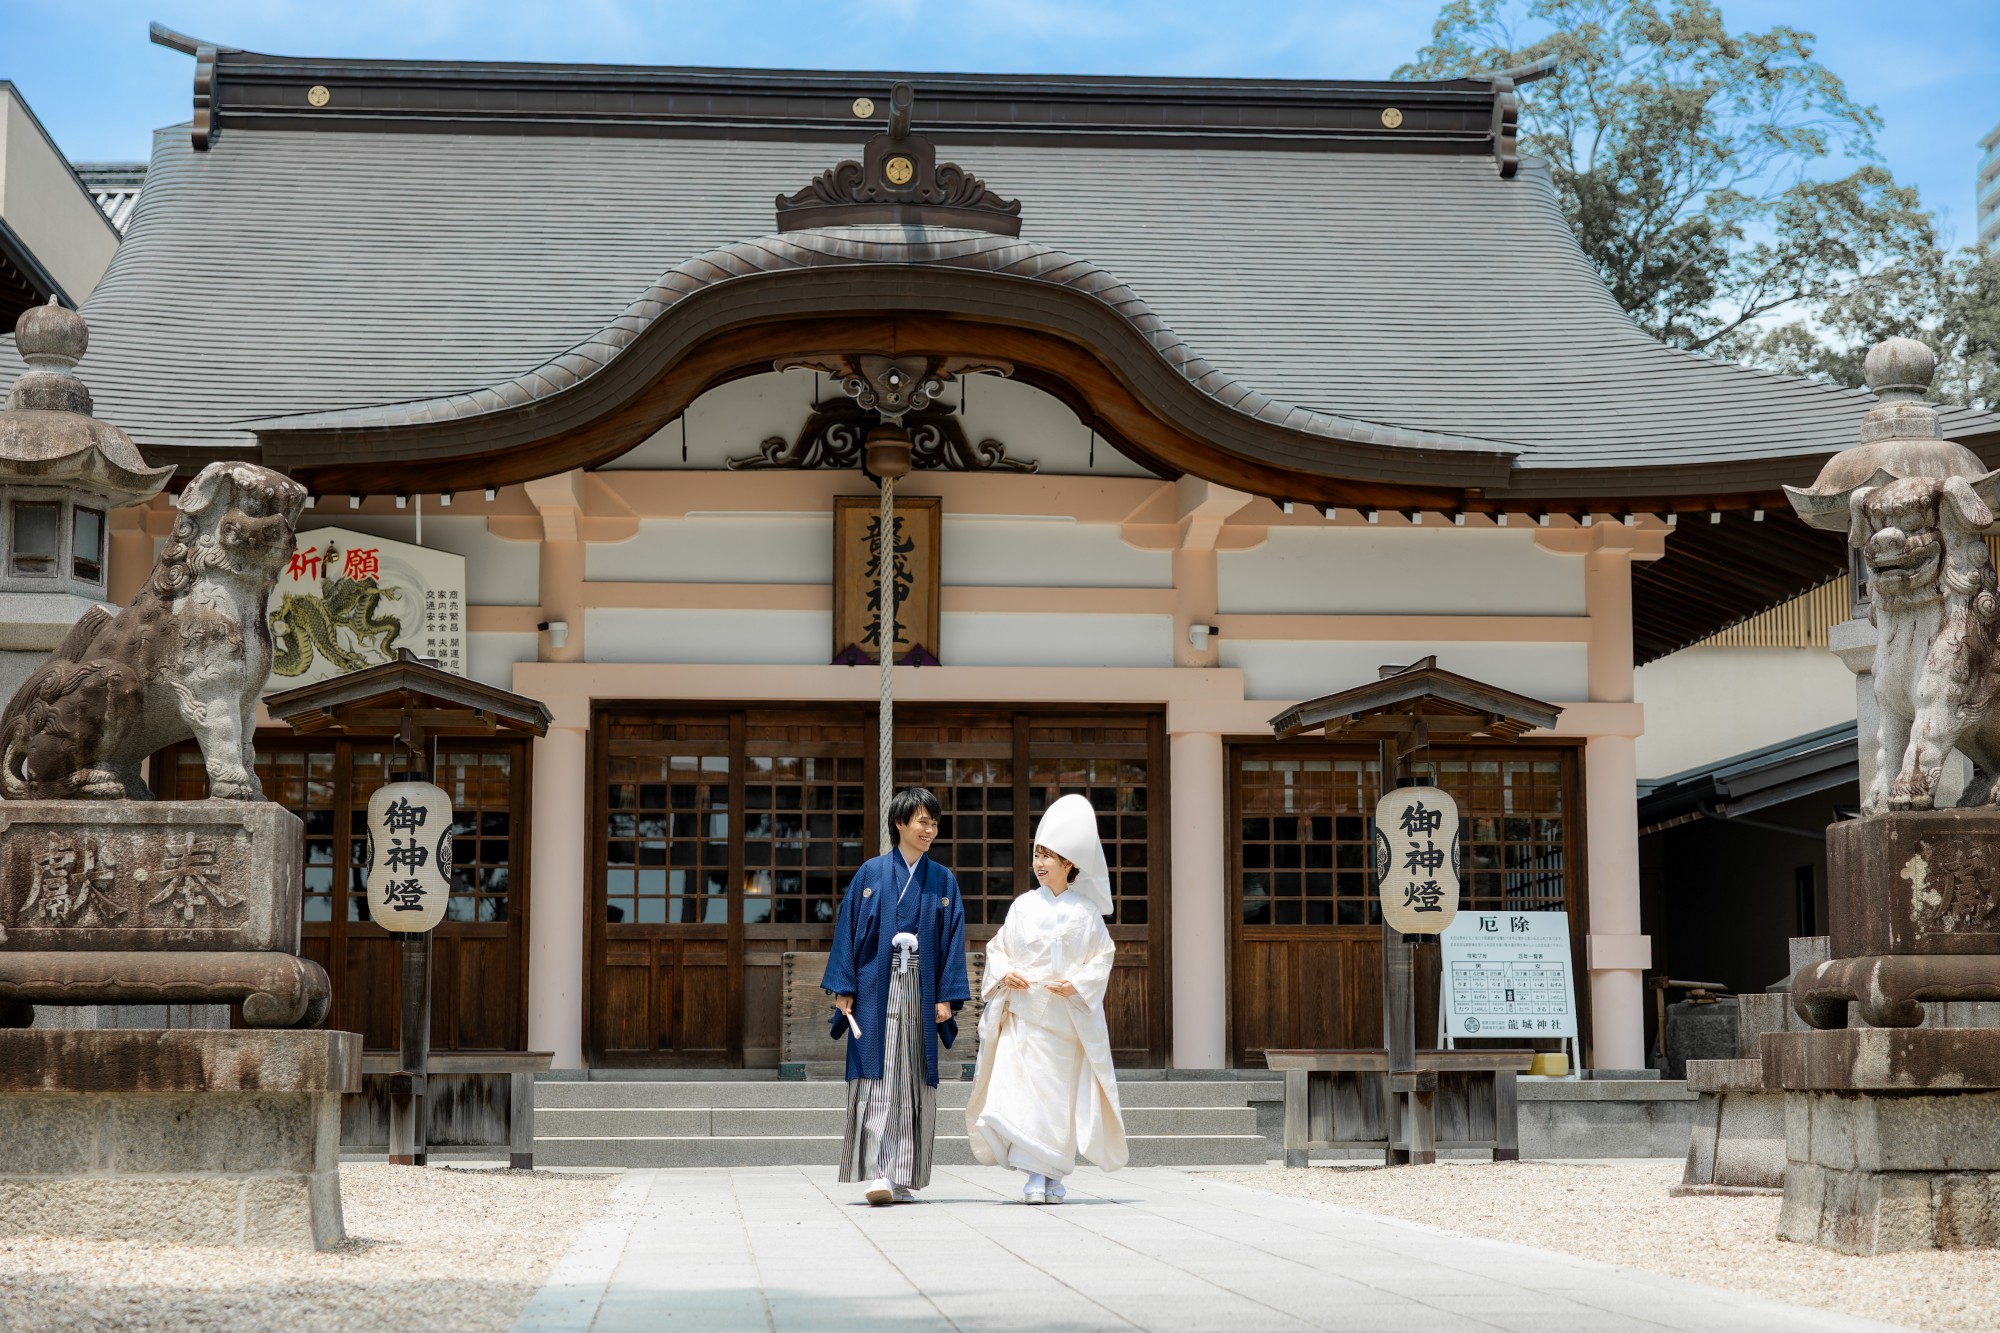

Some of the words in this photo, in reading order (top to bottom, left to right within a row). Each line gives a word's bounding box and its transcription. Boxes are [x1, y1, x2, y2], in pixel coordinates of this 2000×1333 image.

[286, 546, 381, 582] 祈願
[426, 590, 436, 632] 交通安全
[438, 590, 448, 632] 家内安全
[449, 590, 459, 632] 商売繁昌
[382, 797, 429, 912] 御神燈
[1400, 800, 1445, 913] 御神燈
[1478, 916, 1530, 932] 厄除
[1508, 1019, 1562, 1030] 龍城神社
